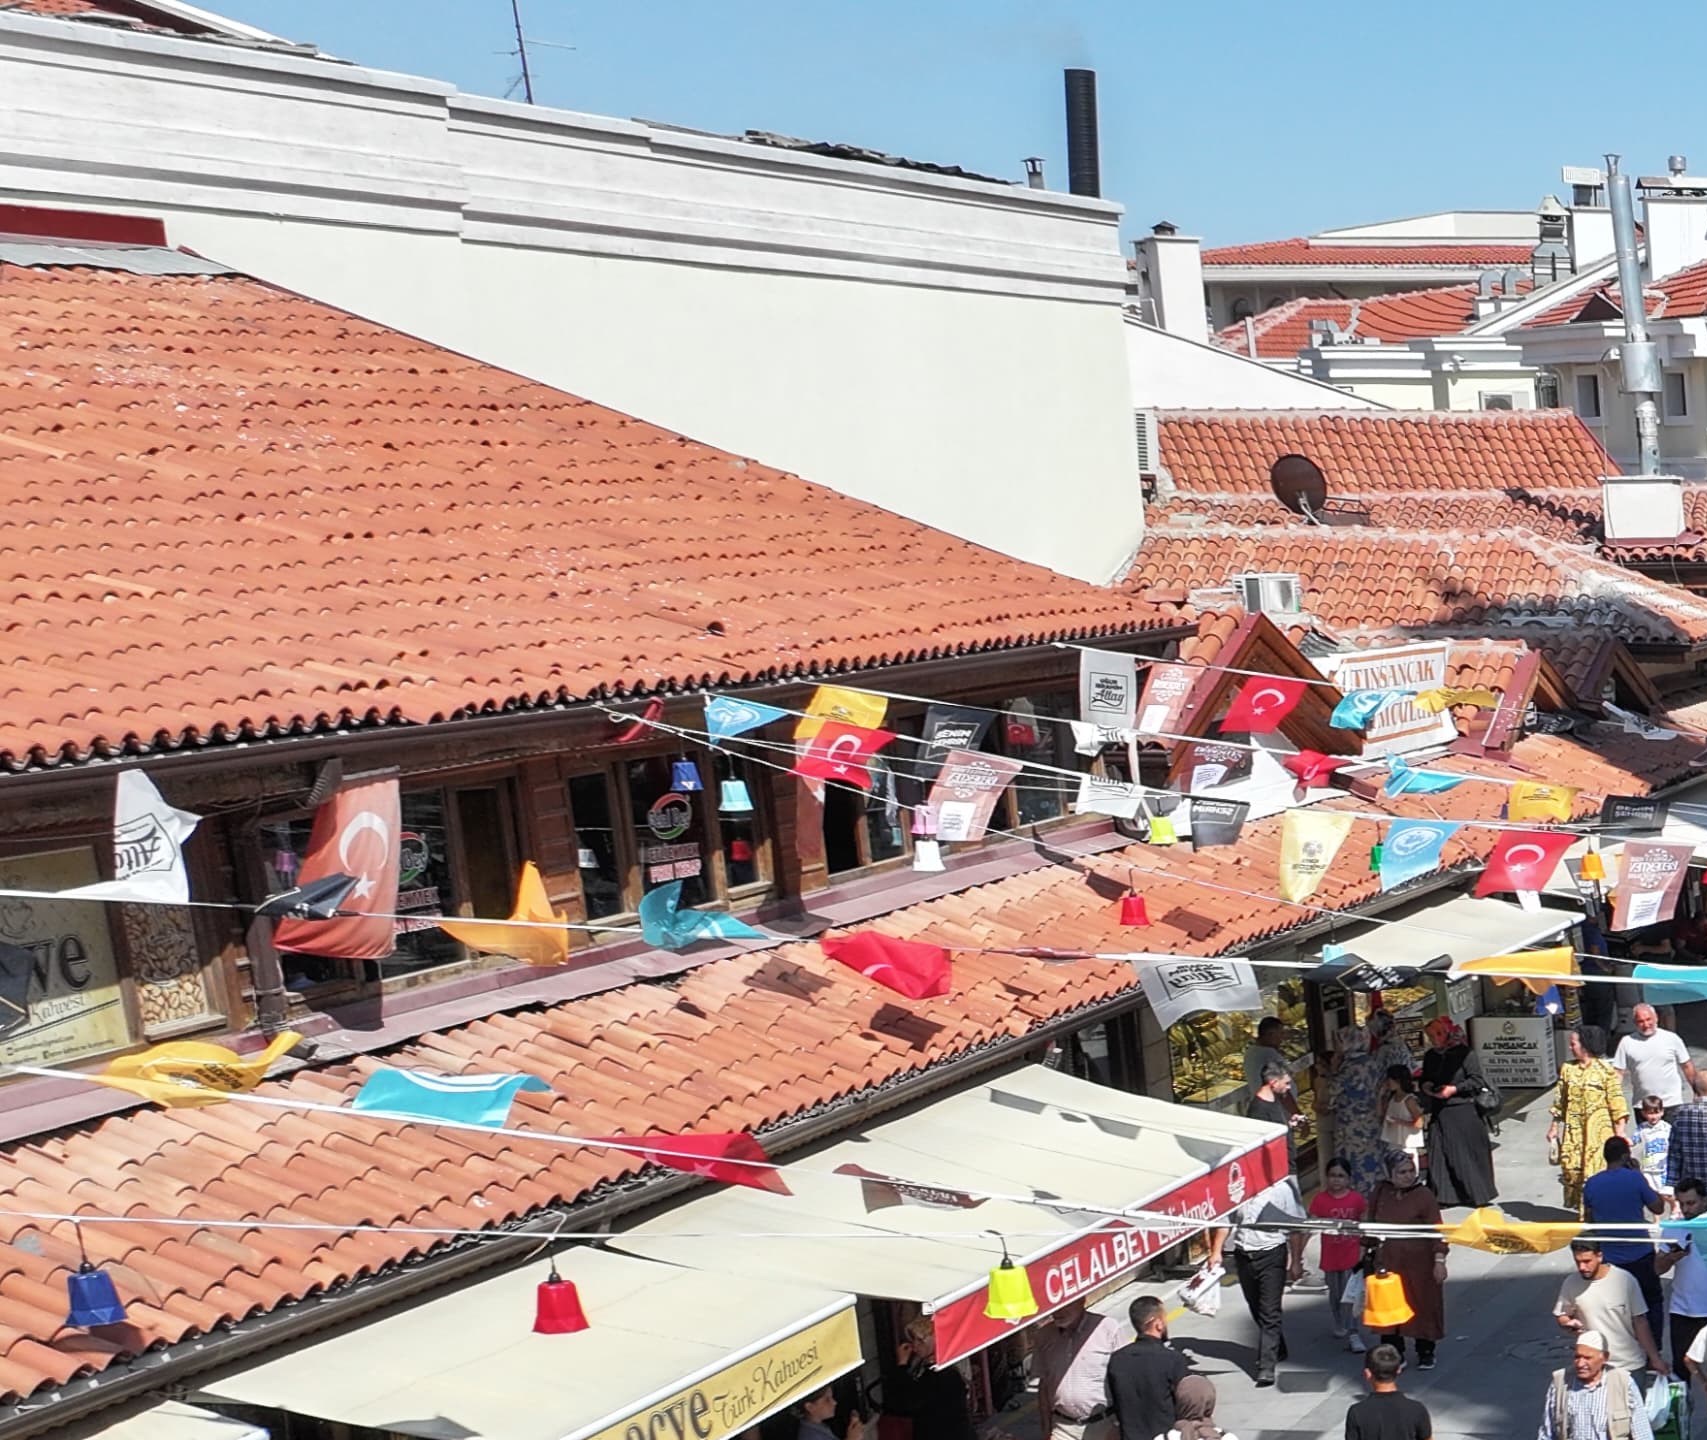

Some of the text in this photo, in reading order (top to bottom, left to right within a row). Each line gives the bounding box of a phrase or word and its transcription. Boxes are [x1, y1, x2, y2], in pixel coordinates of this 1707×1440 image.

[1045, 1228, 1152, 1305] CELALBEY
[713, 1384, 756, 1428] Türk
[752, 1340, 820, 1400] Kahvesi
